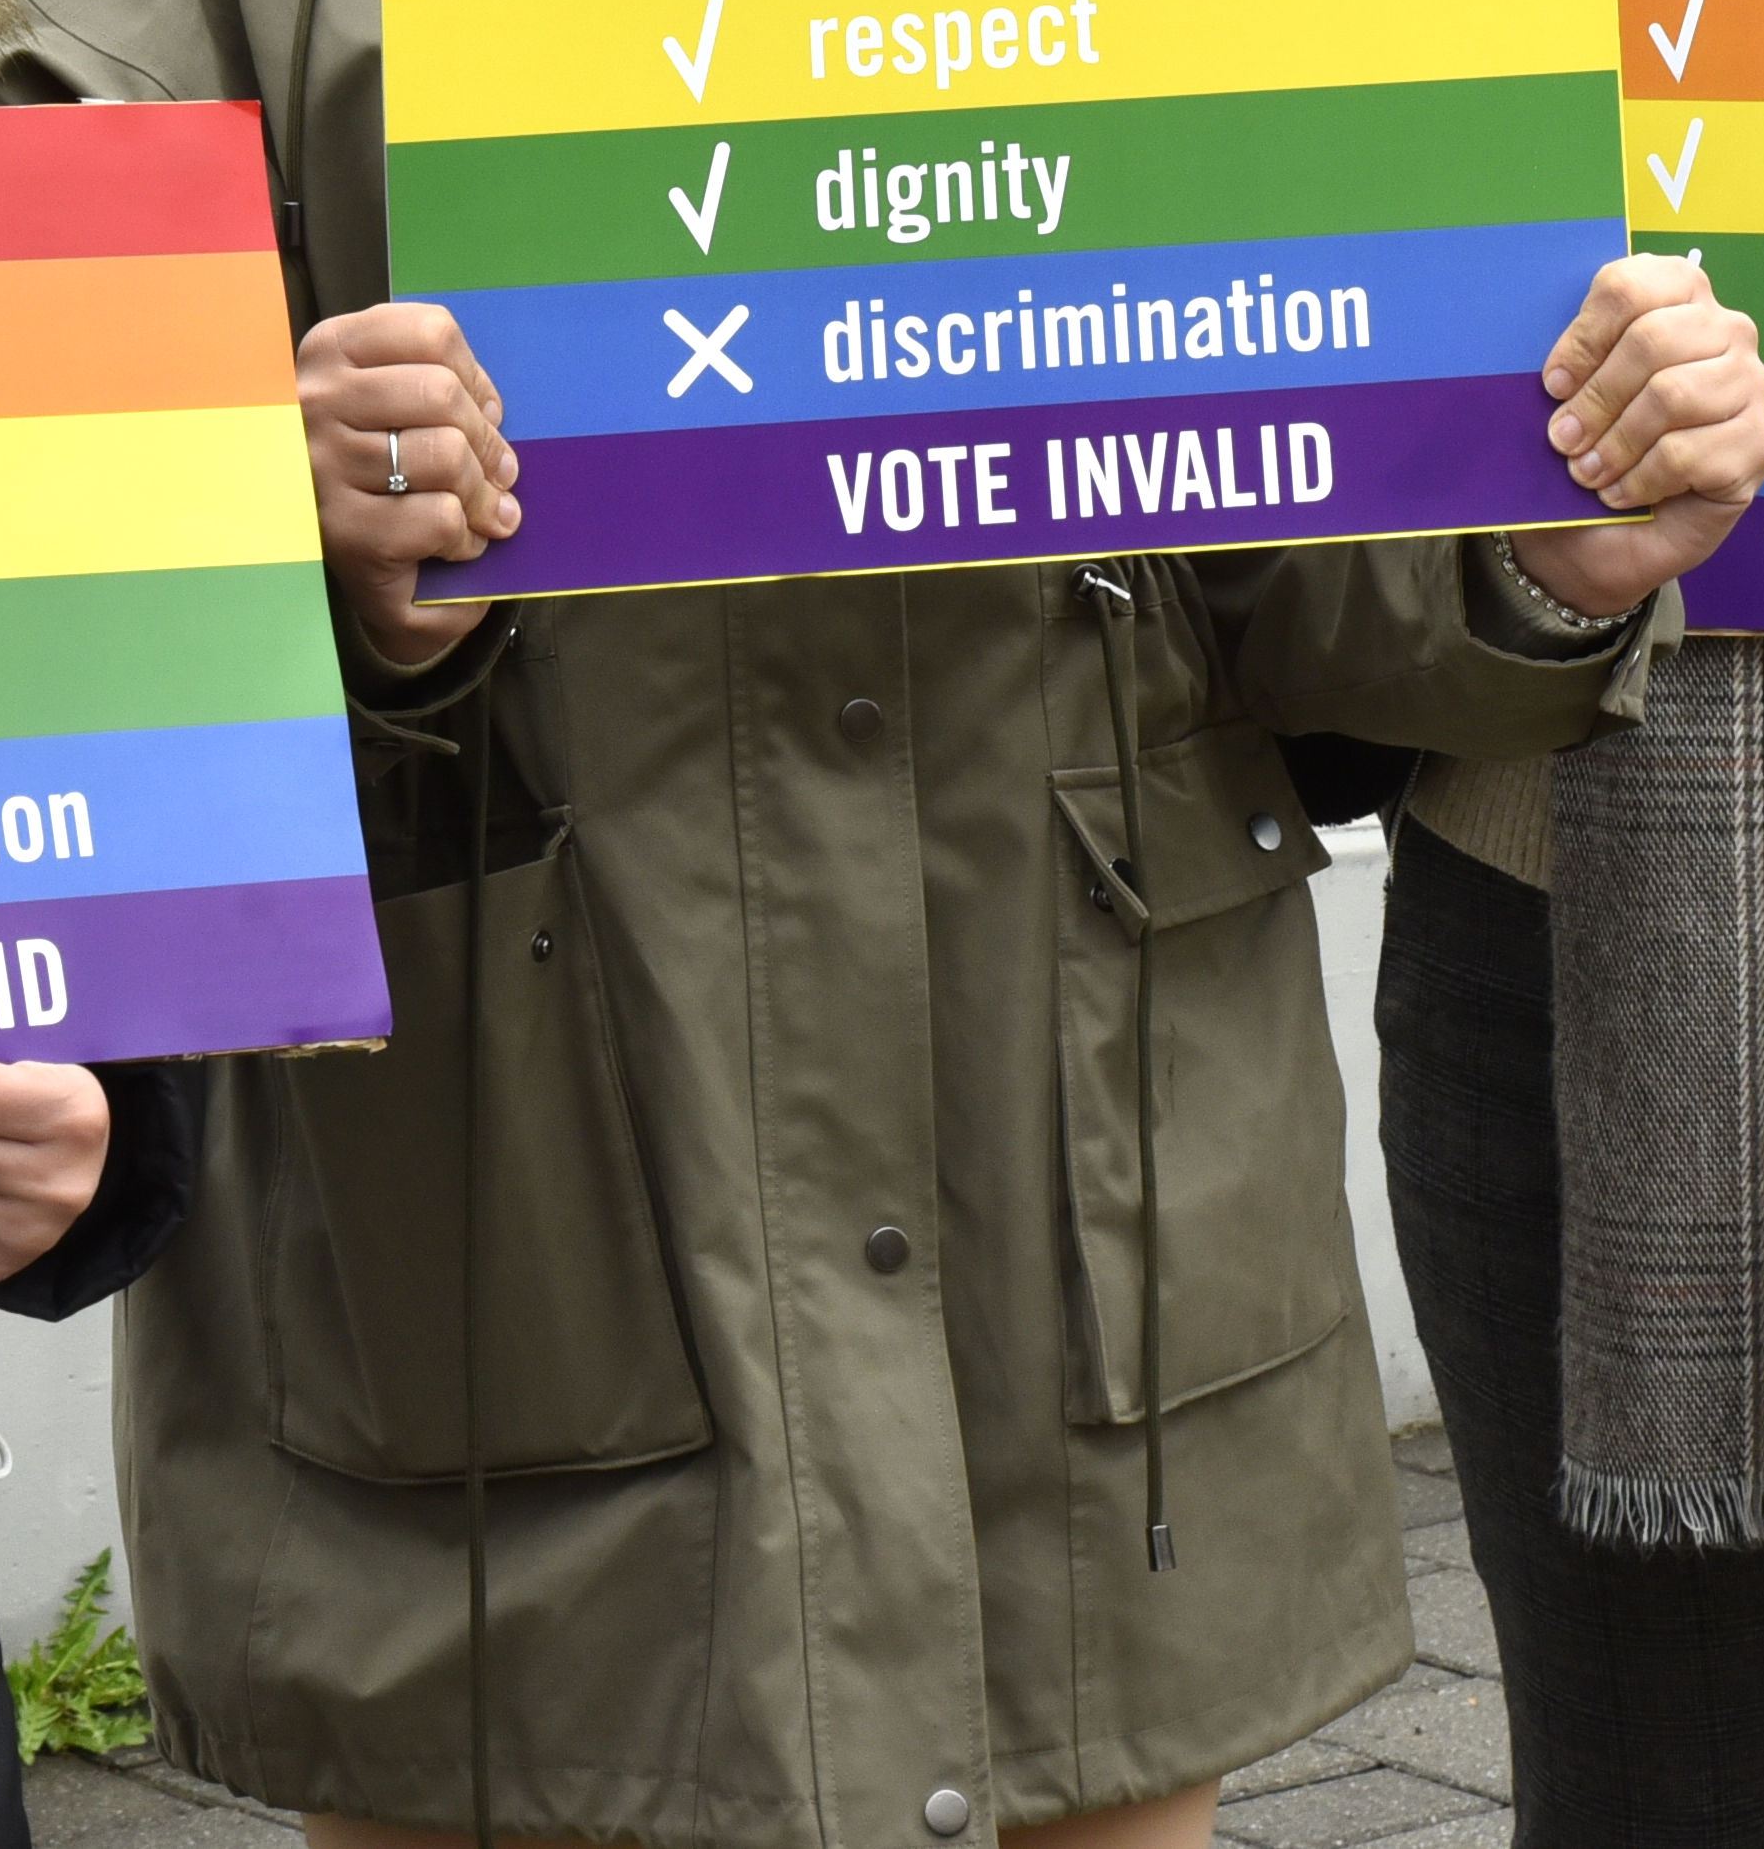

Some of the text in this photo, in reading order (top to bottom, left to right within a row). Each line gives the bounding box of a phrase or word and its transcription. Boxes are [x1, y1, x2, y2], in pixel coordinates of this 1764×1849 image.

[816, 141, 1070, 243] dignity
[824, 274, 1369, 382] discrimination
[827, 423, 1332, 534] VOTE INVALID
